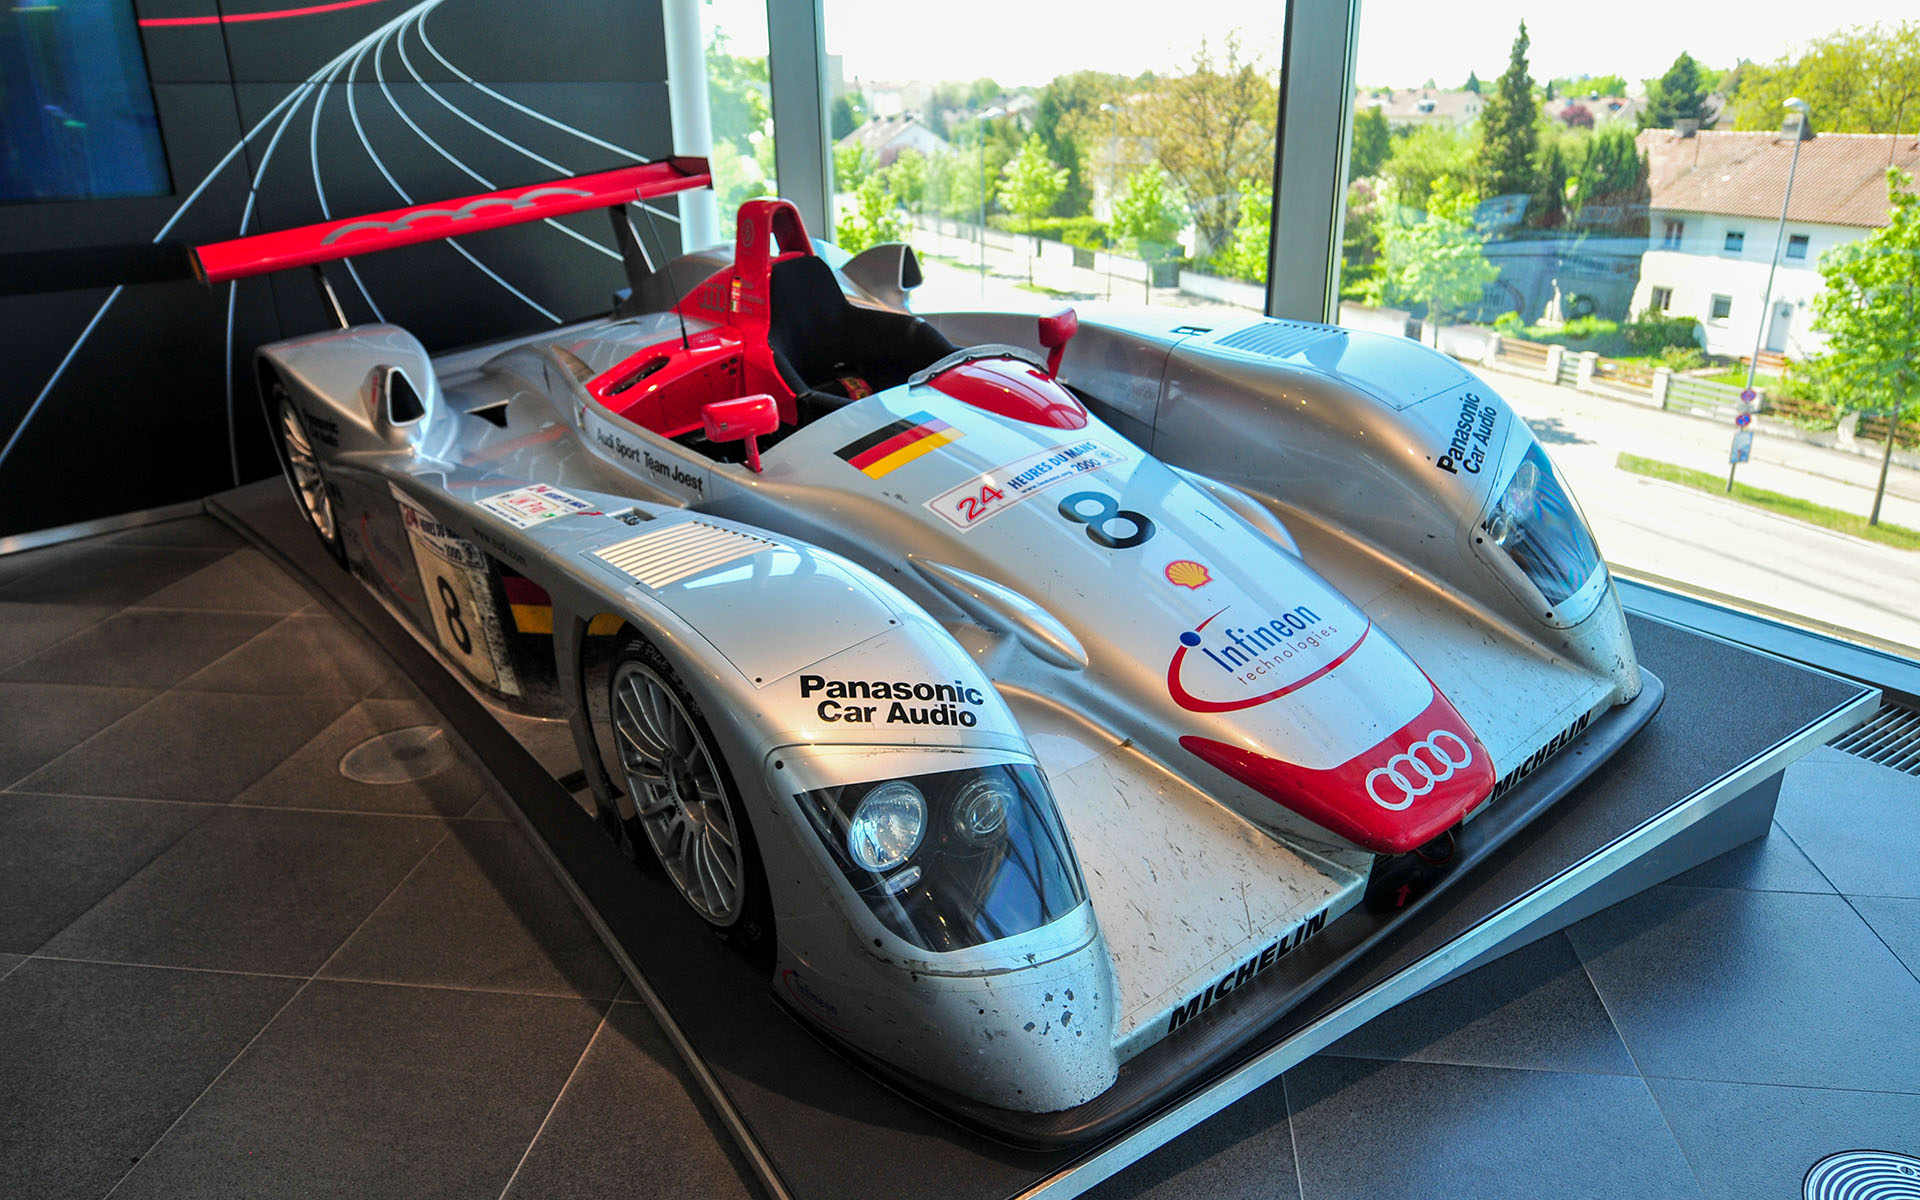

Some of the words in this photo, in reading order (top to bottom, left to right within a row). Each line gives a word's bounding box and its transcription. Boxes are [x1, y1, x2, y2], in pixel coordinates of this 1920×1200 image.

[1436, 392, 1481, 475] Panasonic
[1472, 406, 1497, 446] Audio
[597, 428, 615, 449] Audi
[616, 437, 640, 462] Sport
[643, 451, 670, 477] Team
[671, 465, 703, 492] Joest
[957, 484, 1004, 522] 24
[1007, 461, 1053, 490] HEURES
[1050, 453, 1069, 467] DU
[1064, 441, 1097, 460] MANS
[1070, 458, 1101, 472] 2000
[1463, 444, 1486, 474] Car
[1058, 491, 1156, 549] 8
[437, 575, 472, 655] 8
[1202, 604, 1322, 674] Infineon
[1237, 624, 1338, 687] technologies
[800, 674, 984, 706] Panasonic
[817, 701, 877, 722] Car
[886, 702, 977, 727] Audio
[1493, 709, 1591, 803] MICHELIN
[1167, 908, 1329, 1035] MICHELIN
